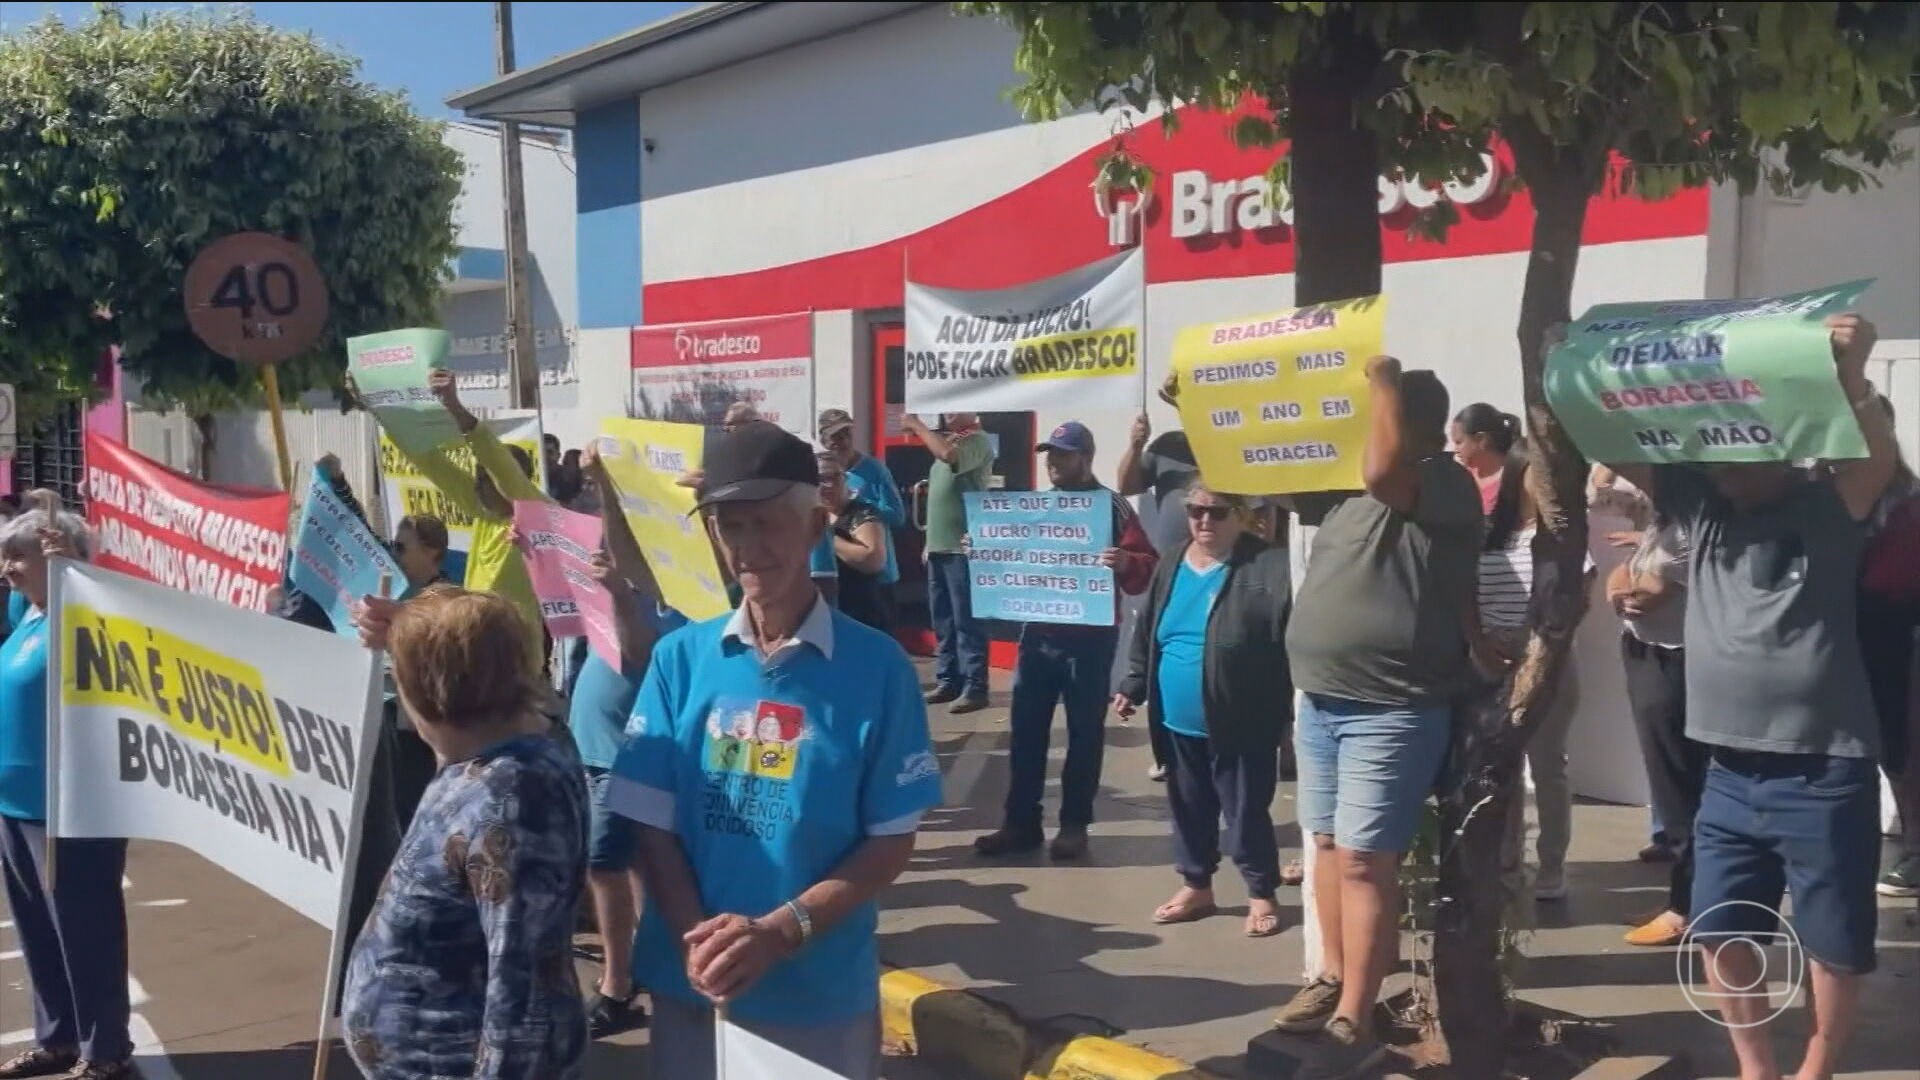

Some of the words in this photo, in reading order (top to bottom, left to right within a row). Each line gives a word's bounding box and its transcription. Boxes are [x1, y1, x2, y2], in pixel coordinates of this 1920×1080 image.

[210, 262, 299, 318] 40
[935, 314, 989, 344] AQUI
[1022, 297, 1092, 338] LUCRO!
[693, 331, 761, 359] bradesco
[906, 350, 948, 380] PODE
[952, 349, 1009, 379] FICAR
[1012, 331, 1137, 375] BRADESCO!
[1612, 333, 1725, 367] DEIXAR
[1193, 361, 1277, 383] PEDIMOS
[1296, 351, 1346, 372] MAIS
[1211, 410, 1241, 427] UM
[1262, 403, 1302, 420] ANO
[1322, 399, 1352, 416] EM
[1635, 429, 1681, 446] NA
[1018, 497, 1049, 510] QUE
[1058, 496, 1092, 509] DEU
[979, 525, 1031, 538] LUCRO
[968, 549, 1024, 562] AGORA
[1029, 551, 1104, 566] DESPREZ
[976, 573, 997, 586] OS
[1003, 573, 1078, 590] CLIENTES
[1088, 579, 1110, 592] DE
[146, 627, 171, 716] É
[176, 657, 283, 763] JUSTO!
[271, 782, 333, 874] NA
